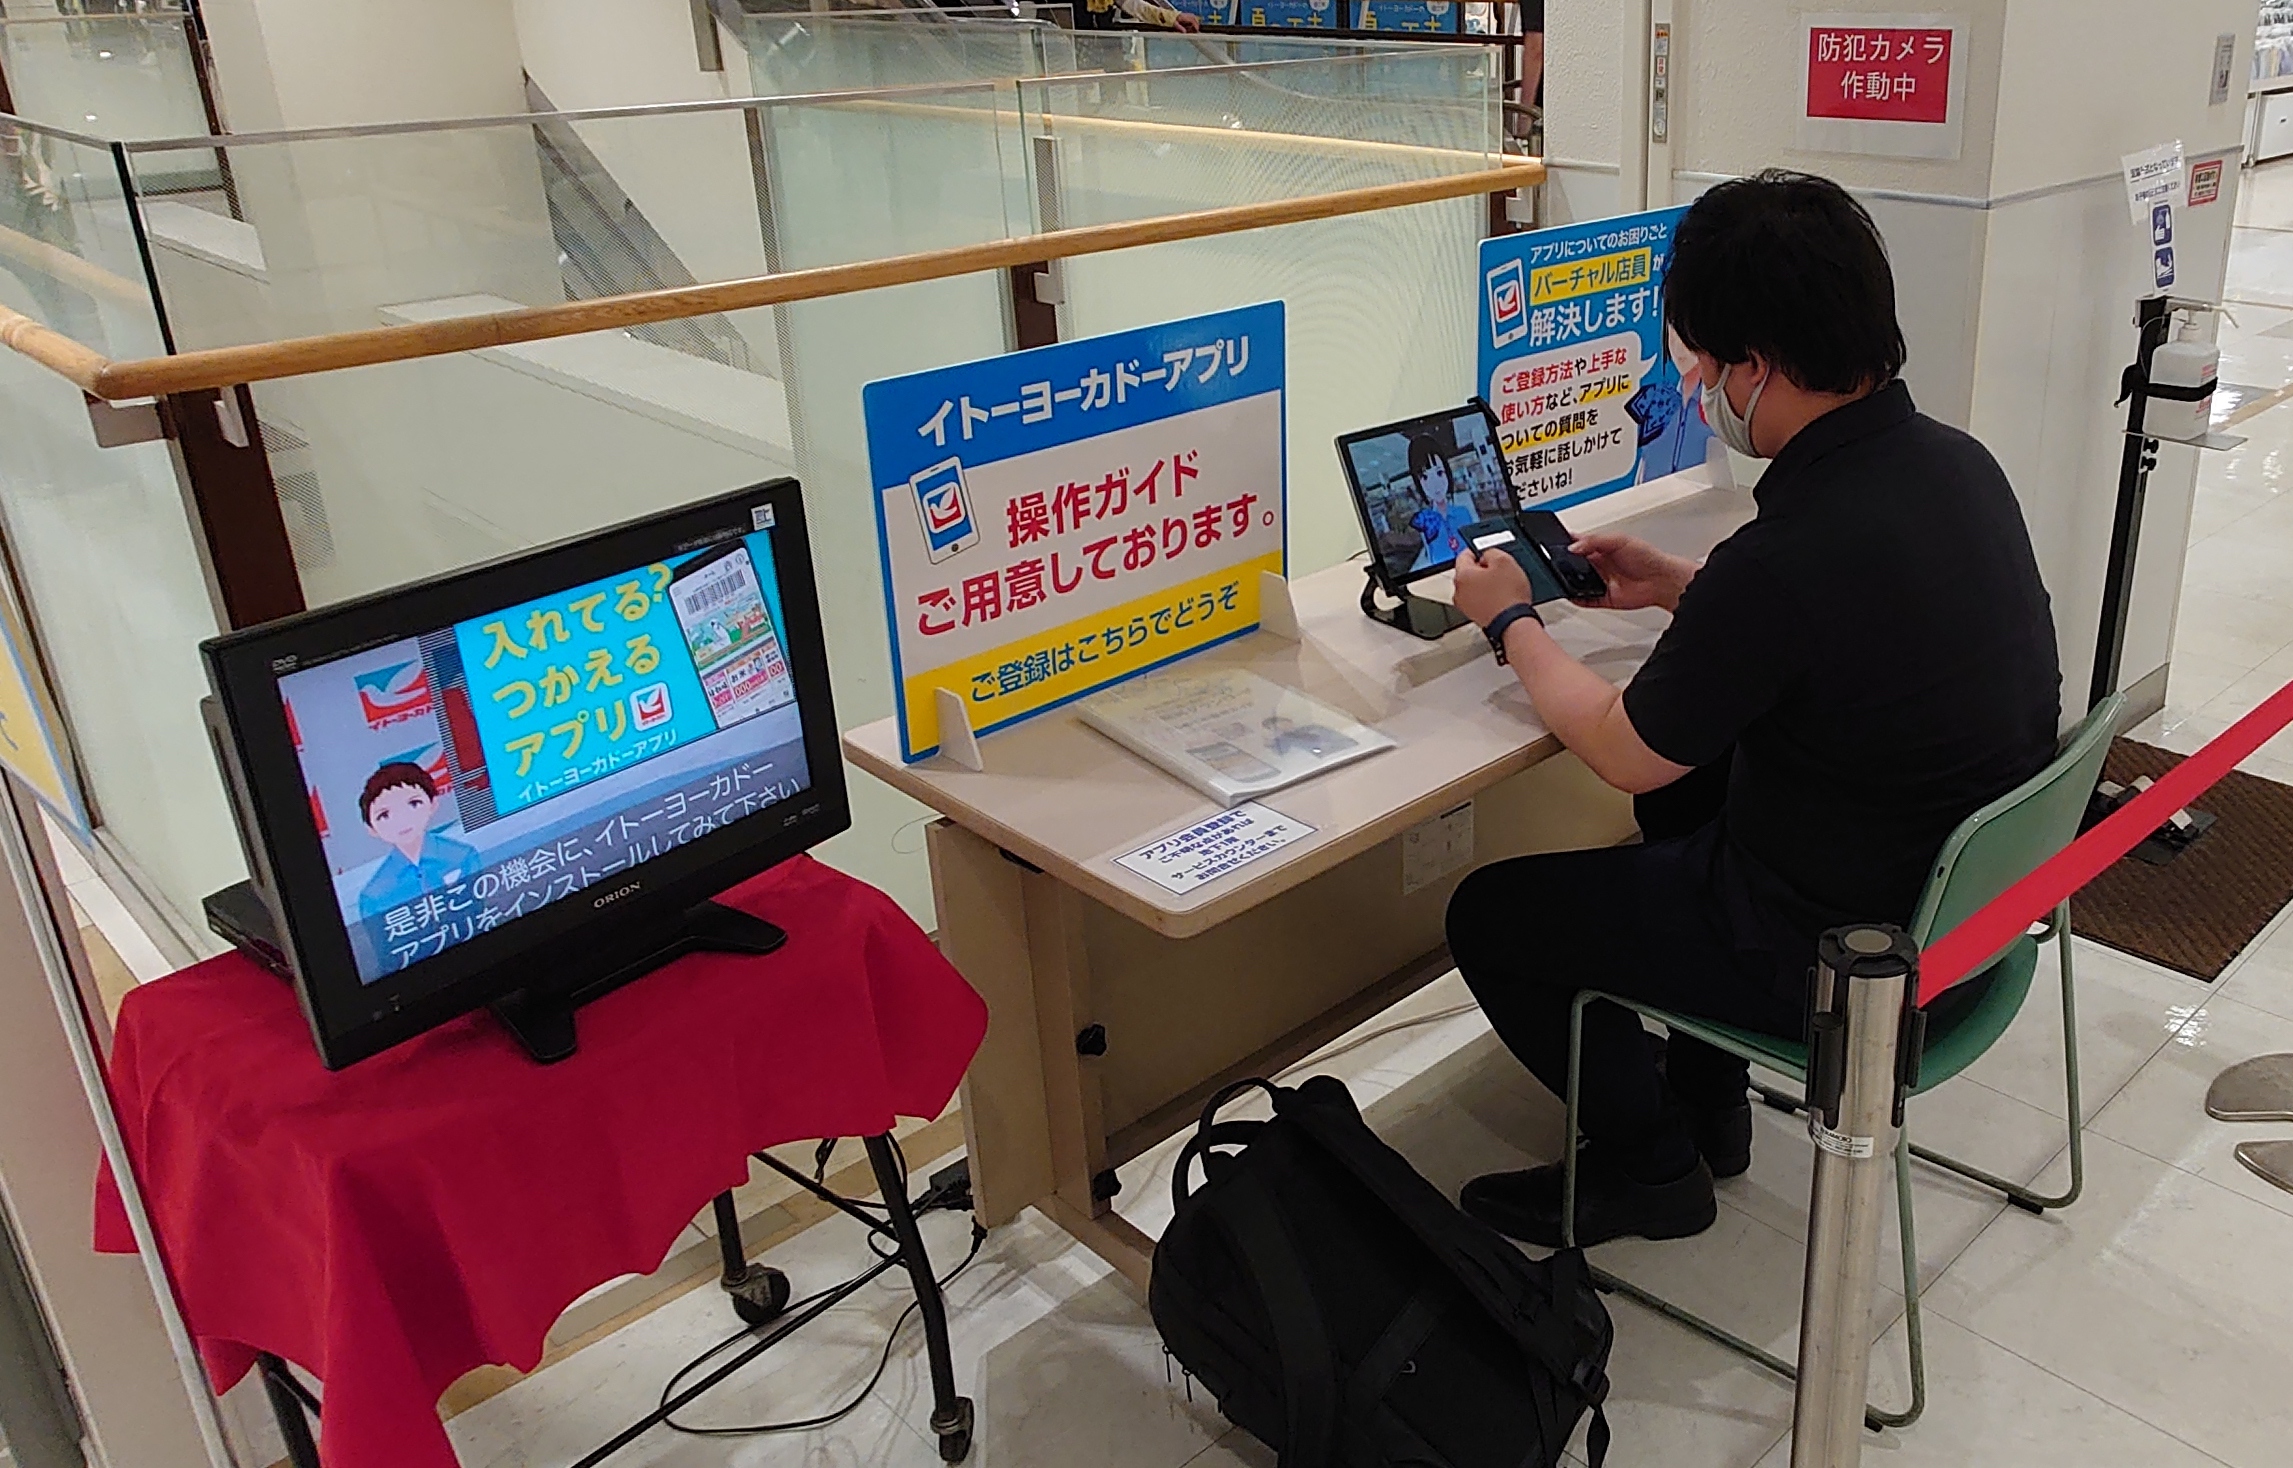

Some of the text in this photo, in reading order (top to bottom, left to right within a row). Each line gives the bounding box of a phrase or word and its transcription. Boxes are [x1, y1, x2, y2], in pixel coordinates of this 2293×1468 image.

[1817, 33, 1945, 64] 防犯カメラ
[1840, 70, 1916, 101] 作動中
[1530, 222, 1668, 264] アプリについてのお困りごと
[918, 335, 1250, 447] イトーヨーカドーアプリ
[1501, 374, 1629, 425] 使い方など、アプリに
[1502, 347, 1627, 394] ご登録方法や上手な
[1501, 409, 1599, 451] ついての質問を
[1006, 450, 1199, 548] 操作ガイド
[917, 492, 1275, 636] ご用意しております。
[482, 562, 674, 670] 入れてる?
[970, 581, 1240, 702] ご登録はこちらでどうぞ
[493, 633, 661, 719] つかえる
[504, 699, 627, 778] アプリ
[519, 728, 678, 803] イトーヨーカドーアプリ
[384, 762, 774, 942] 是非この機会に、イトーヨーカドー
[1139, 809, 1247, 860] アプリ会員登録で
[1171, 824, 1288, 880] サービスカウンターまで
[593, 881, 642, 909] ORION
